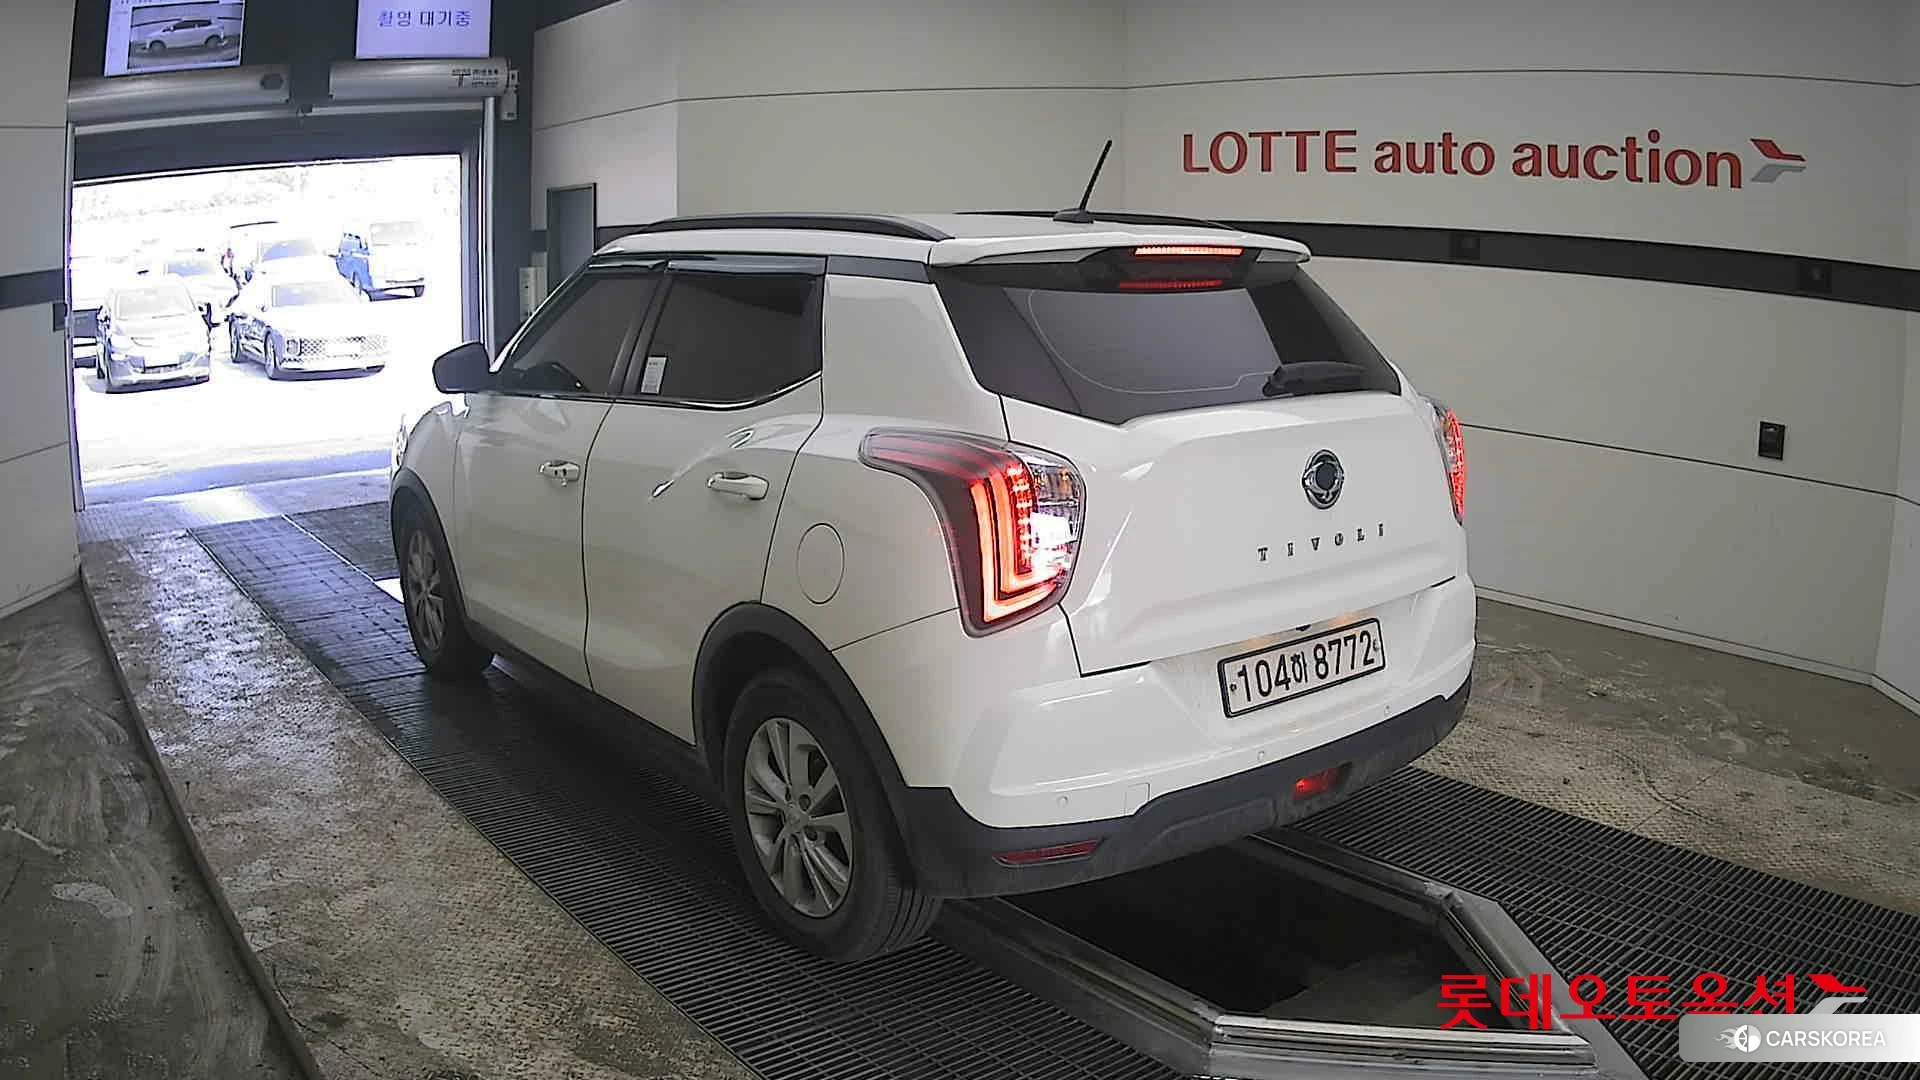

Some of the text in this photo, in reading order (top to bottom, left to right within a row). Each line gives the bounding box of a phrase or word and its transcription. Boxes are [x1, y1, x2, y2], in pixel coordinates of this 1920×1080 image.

[420, 10, 471, 27] 대기중
[1183, 129, 1742, 189] LOTTE auto auction
[1258, 523, 1384, 561] TIVOLI
[1238, 630, 1375, 702] 104하 8772
